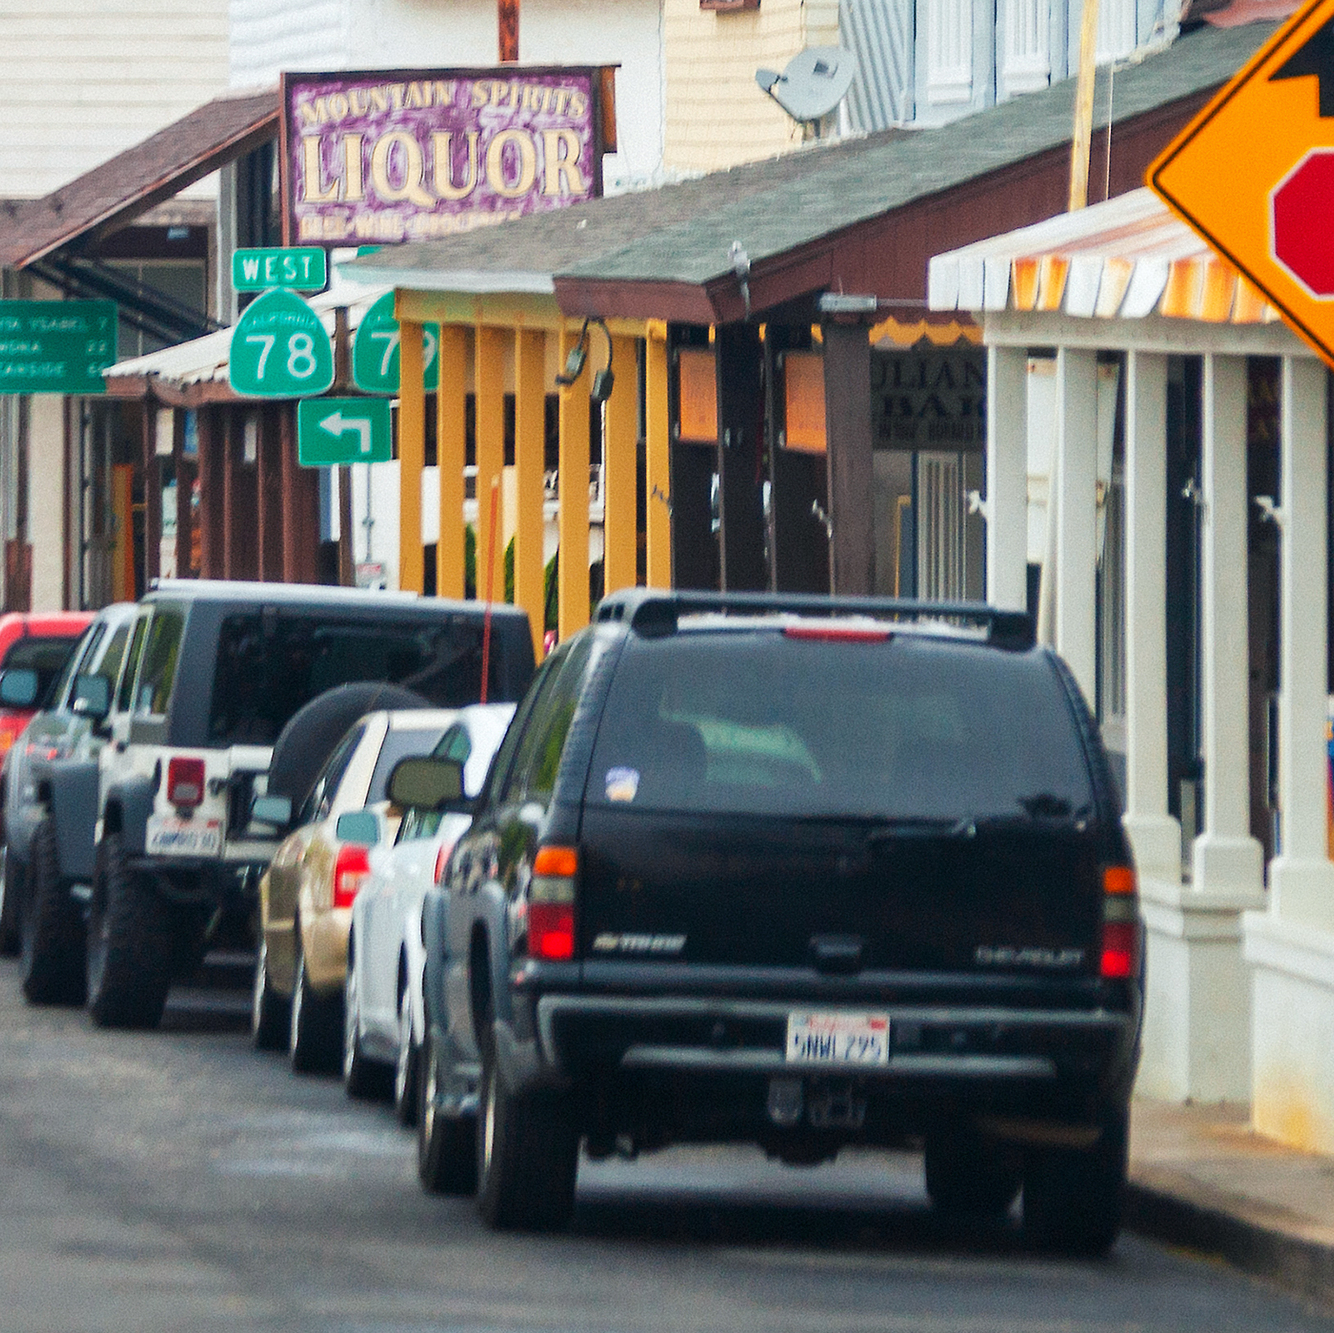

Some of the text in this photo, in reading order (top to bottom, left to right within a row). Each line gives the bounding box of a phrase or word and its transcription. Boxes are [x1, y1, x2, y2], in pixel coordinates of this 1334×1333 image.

[300, 79, 589, 126] MOUNTAIN SPIRITS
[302, 127, 588, 208] LIQUOR
[242, 256, 314, 281] WEST
[245, 332, 317, 380] 78
